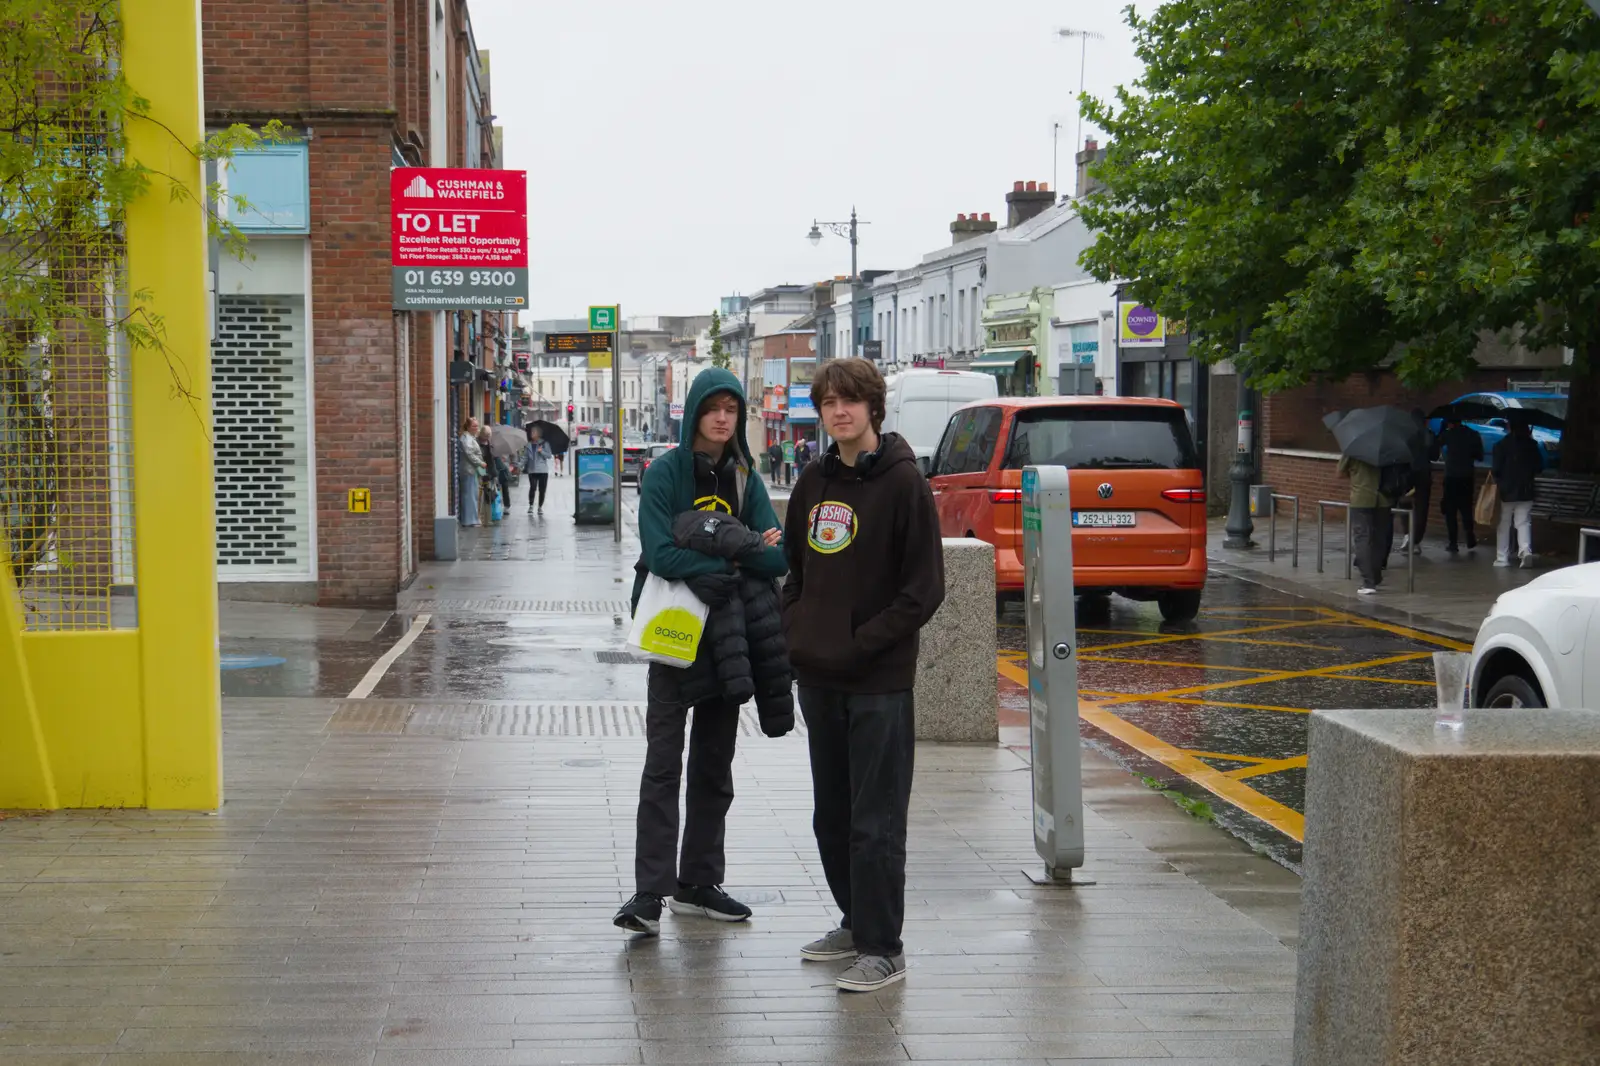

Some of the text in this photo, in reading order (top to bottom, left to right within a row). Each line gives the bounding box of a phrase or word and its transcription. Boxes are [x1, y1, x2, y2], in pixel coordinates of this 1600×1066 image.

[437, 180, 504, 190] CUSHMAN &
[438, 190, 504, 200] WAKEFIELD
[397, 214, 480, 233] TO LET
[470, 237, 520, 246] Opportunity
[405, 271, 515, 286] 01 639 9300
[405, 295, 502, 304] cushmanwakefield.ie
[352, 491, 367, 510] H
[811, 505, 852, 524] GBSHITE
[1083, 515, 1132, 523] 252-LH-332
[655, 626, 693, 643] eason
